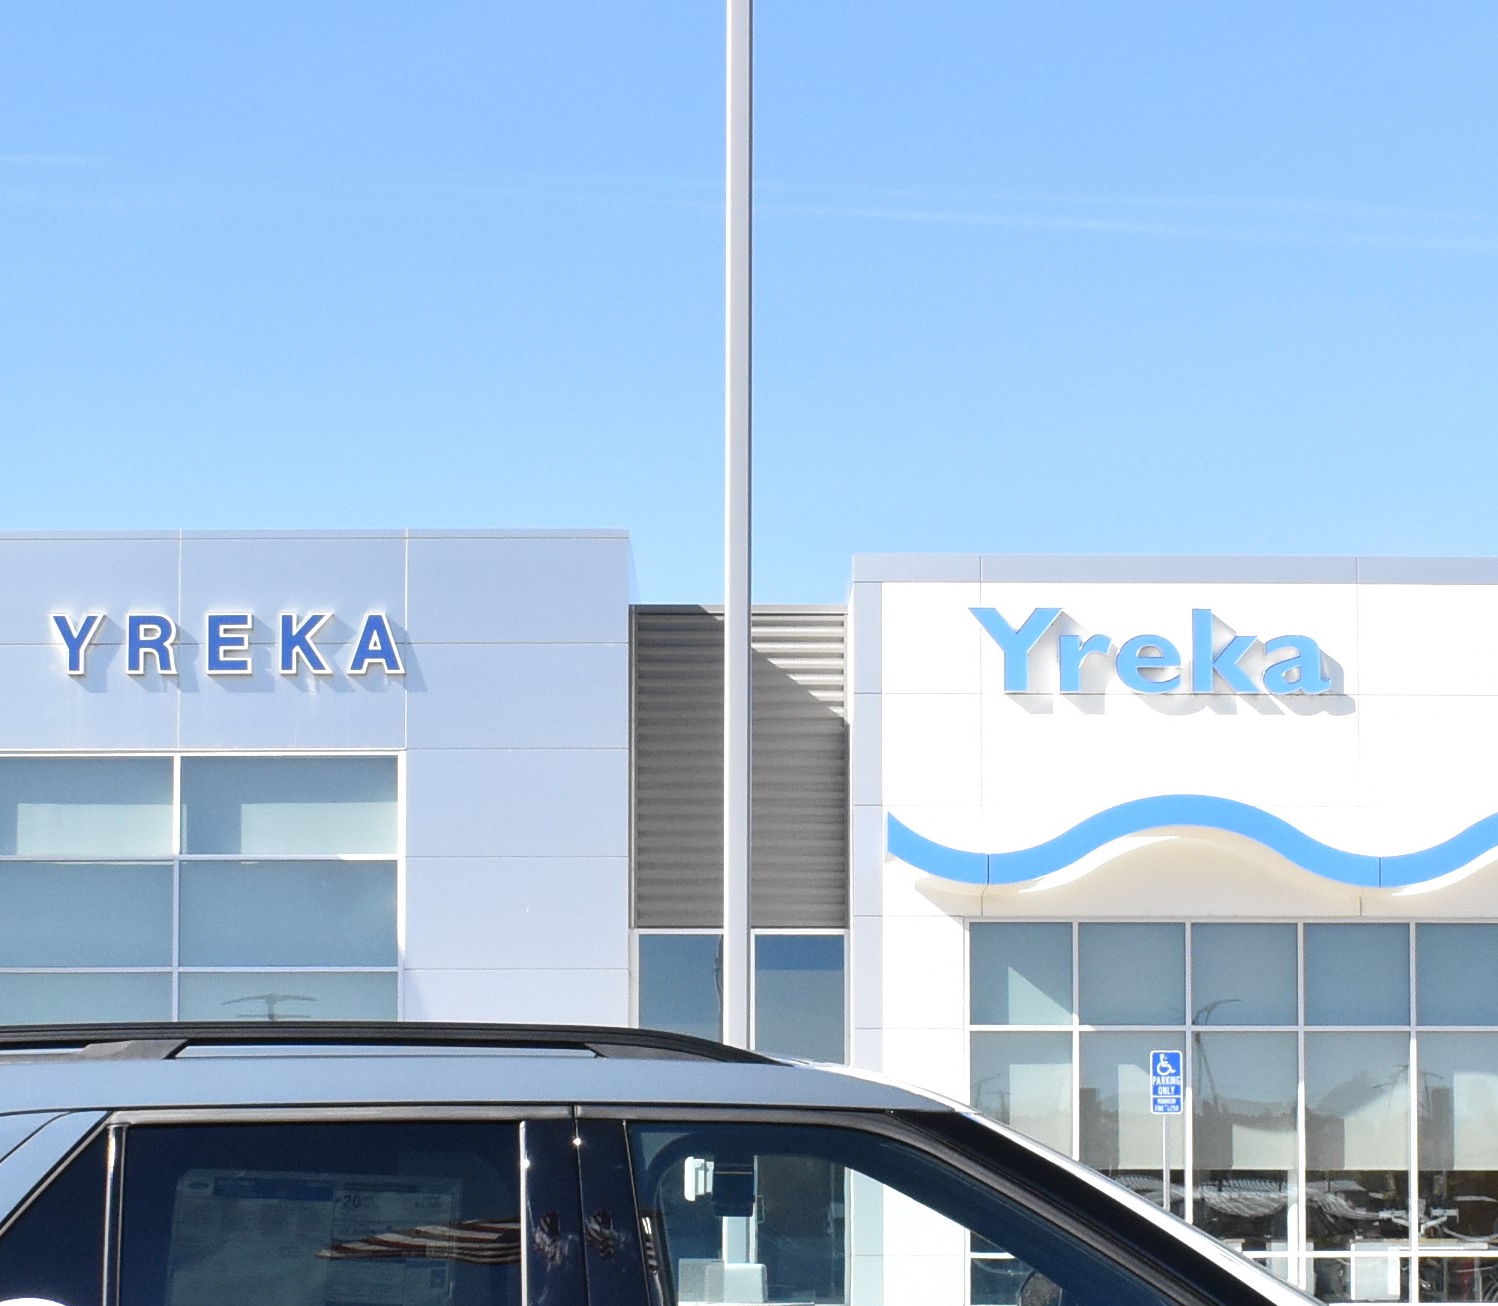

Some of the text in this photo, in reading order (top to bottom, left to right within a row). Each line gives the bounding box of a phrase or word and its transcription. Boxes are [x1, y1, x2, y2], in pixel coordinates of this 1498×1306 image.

[50, 611, 406, 677] YREKA
[968, 607, 1333, 696] Yreka
[1152, 1075, 1181, 1085] PARKING
[1157, 1085, 1176, 1095] ONLY
